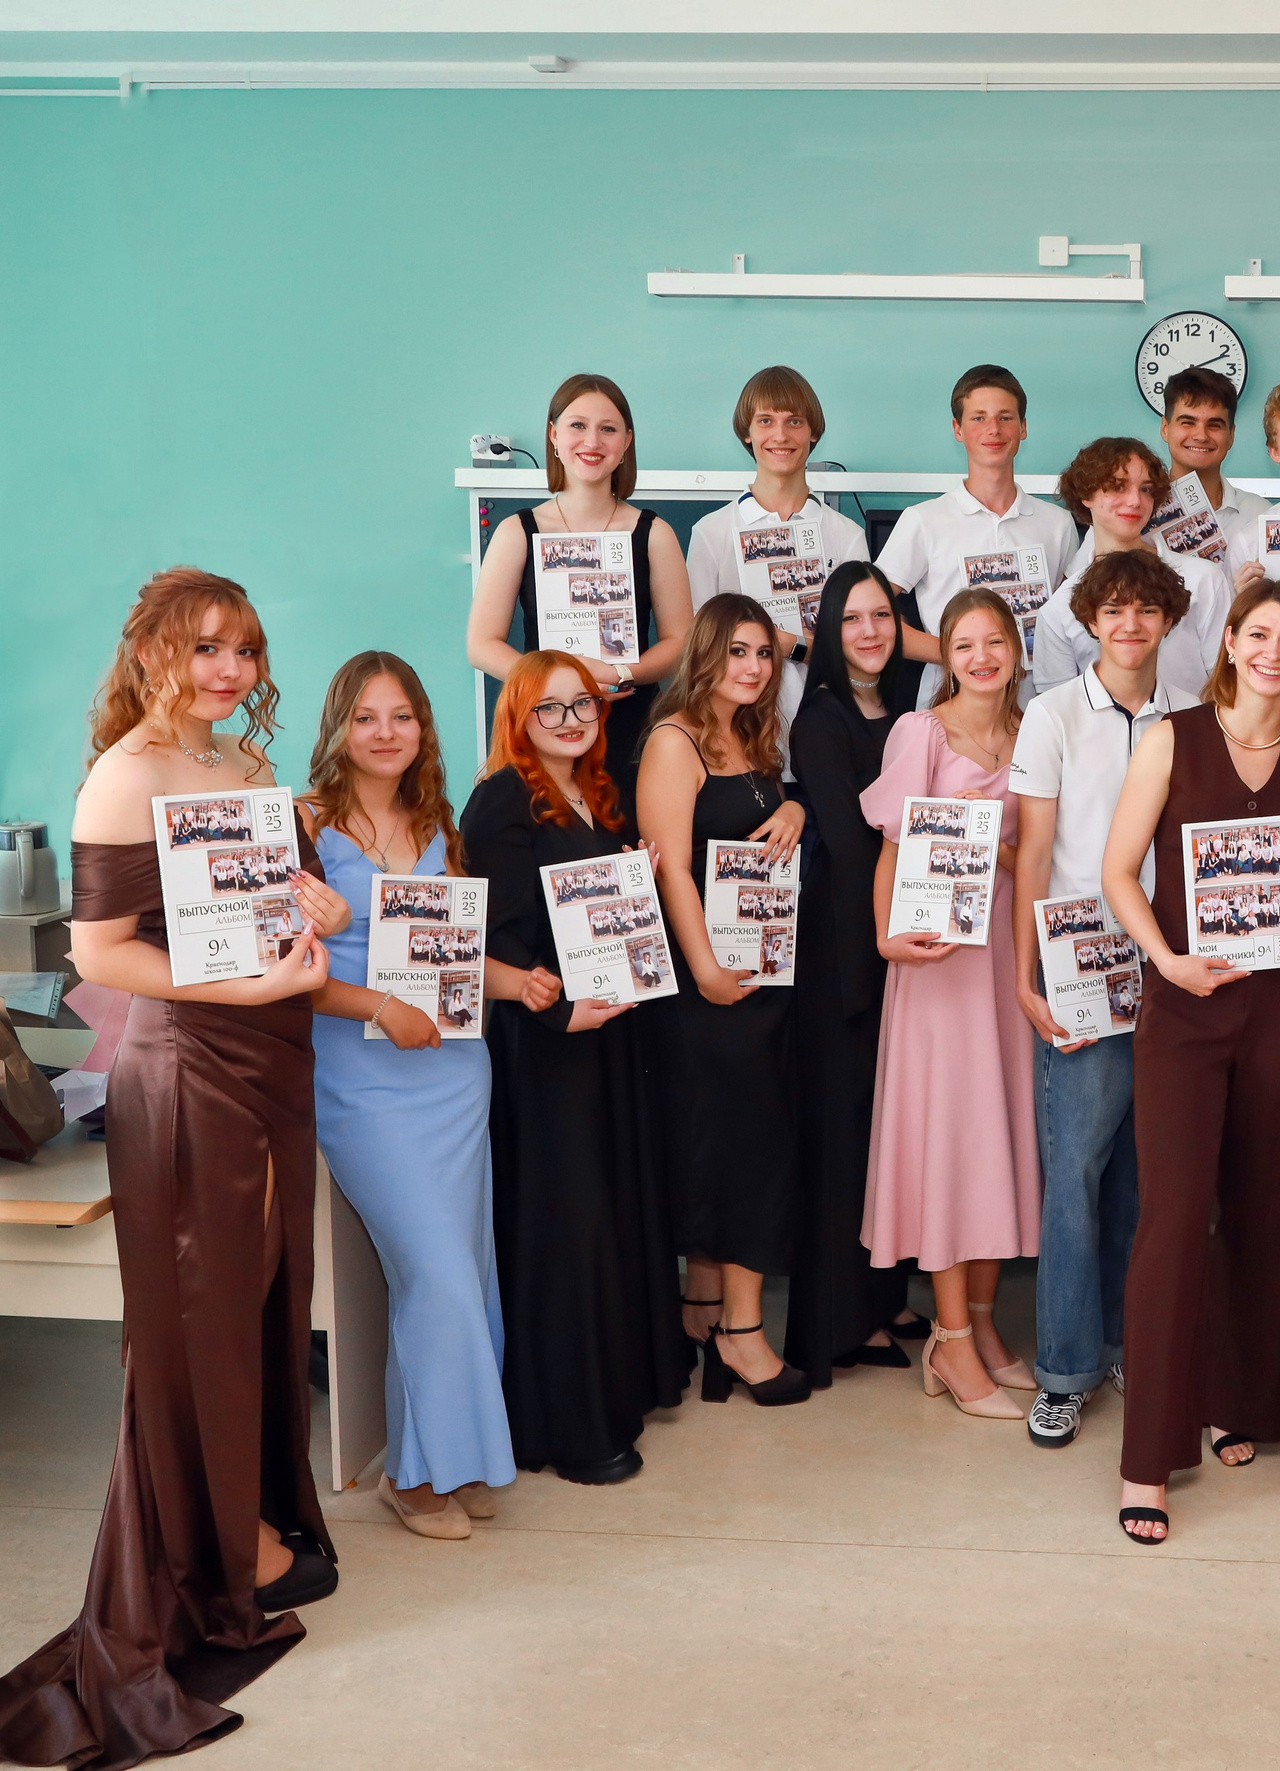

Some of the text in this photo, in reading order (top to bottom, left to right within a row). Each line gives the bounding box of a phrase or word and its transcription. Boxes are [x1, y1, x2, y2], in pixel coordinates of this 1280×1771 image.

[1184, 323, 1201, 336] 12
[1168, 330, 1179, 342] 11
[1209, 330, 1214, 342] 1
[1153, 343, 1169, 356] 10
[1219, 344, 1230, 357] 2
[1147, 362, 1159, 375] 9
[1226, 363, 1236, 376] 3
[1153, 381, 1165, 394] 8
[1183, 485, 1195, 495] 20
[1187, 492, 1199, 502] 25
[802, 529, 814, 537] 20
[804, 538, 815, 548] 25
[611, 552, 623, 562] 25
[1026, 555, 1037, 563] 20
[1028, 563, 1038, 572] 25
[760, 596, 797, 608] ПУСКНОЙ
[546, 611, 596, 620] ВЫПУСКНОЙ
[565, 636, 580, 649] 9А
[263, 803, 281, 814] 20
[265, 815, 282, 829] 25
[977, 812, 990, 820] 20
[976, 821, 989, 832] 25
[627, 863, 641, 872] 20
[629, 872, 644, 884] 25
[901, 881, 951, 891] ВЫПУСКНОЙ
[462, 891, 477, 900] 20
[178, 900, 250, 918] ВЫПУСКНОЙ
[462, 902, 476, 915] 25
[215, 914, 251, 925] АЛЬБОМ
[915, 908, 931, 922] 9А
[713, 926, 760, 935] ВЫПУСКНОЙ
[208, 938, 230, 957] 9А
[567, 942, 623, 961] ВЫПУСКНОЙ
[1198, 945, 1218, 953] МОИ
[1258, 945, 1272, 958] 9А
[727, 953, 742, 967] 9А
[378, 972, 437, 981] ВЫПУСКНОЙ
[593, 973, 611, 989] 9А
[1055, 977, 1105, 994] ВЫПУСКНОЙ
[1076, 1008, 1092, 1023] 9А
